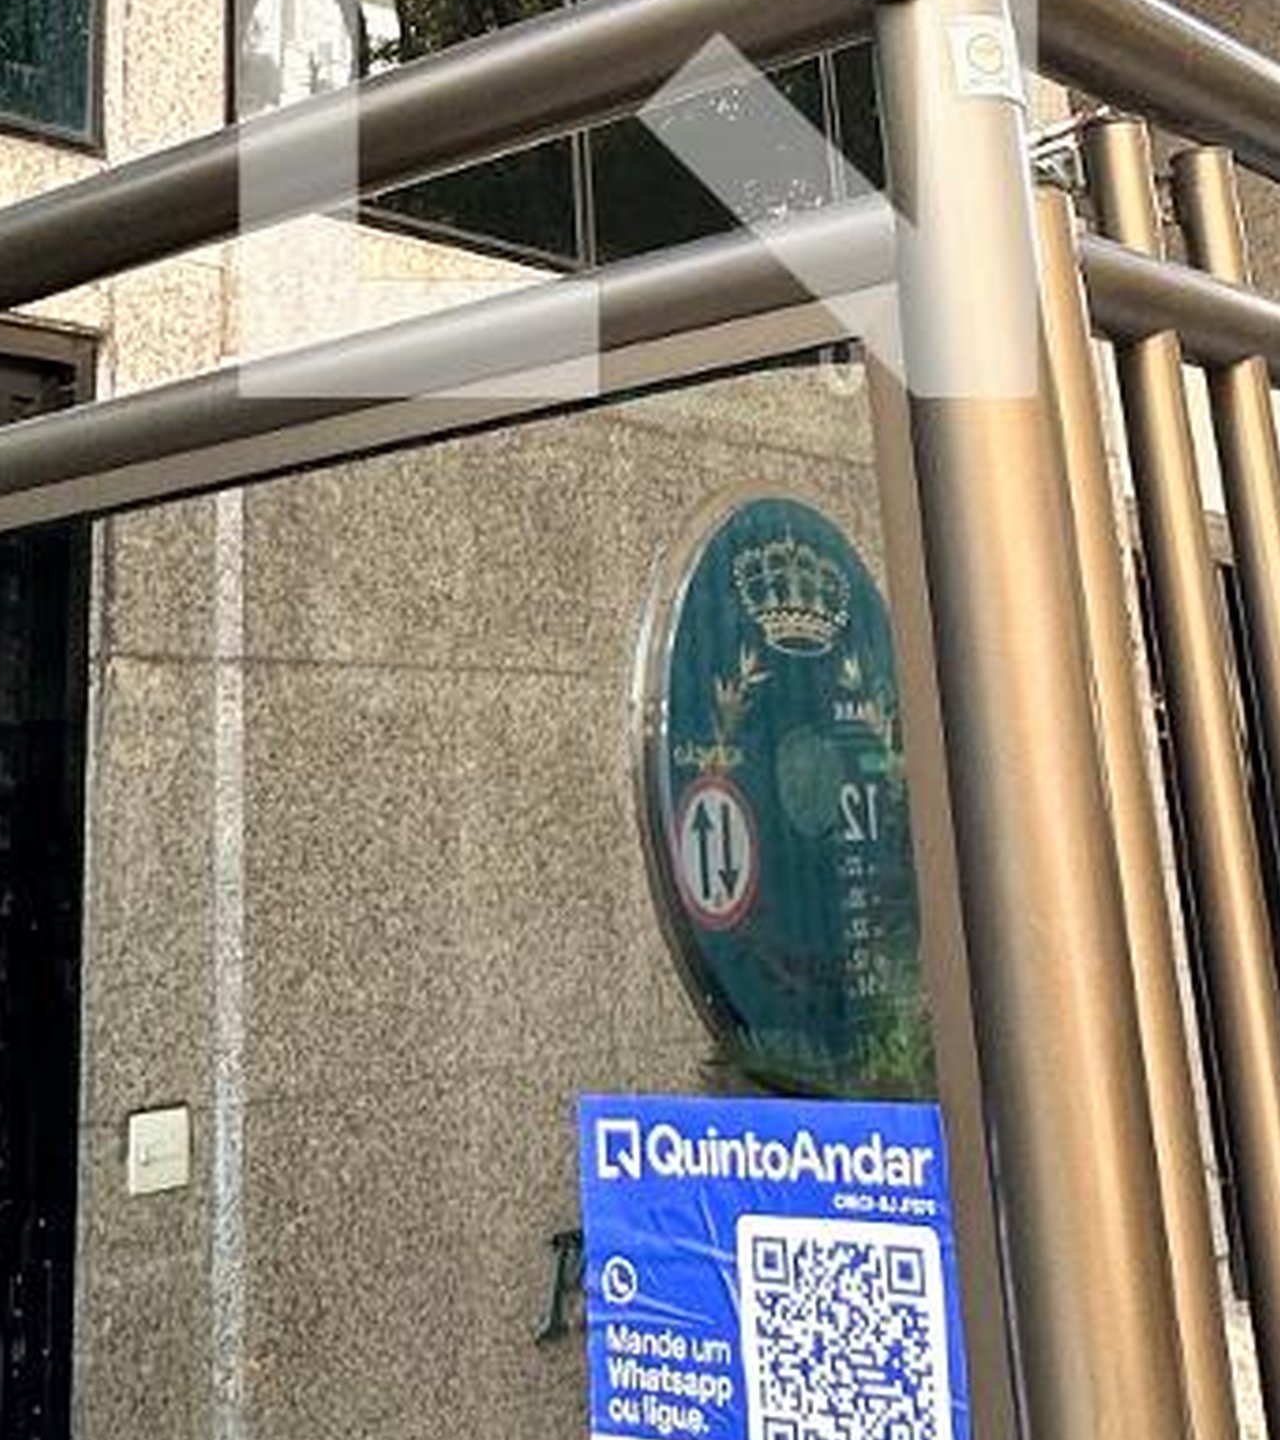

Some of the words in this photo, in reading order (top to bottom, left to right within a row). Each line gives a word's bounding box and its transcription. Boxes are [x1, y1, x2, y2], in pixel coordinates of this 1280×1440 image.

[646, 1123, 934, 1187] QuintoAndar
[606, 1323, 687, 1360] Mande
[691, 1337, 732, 1367] um
[608, 1357, 733, 1407] Whatsapp
[609, 1397, 641, 1423] ou
[644, 1395, 710, 1437] ligue.
